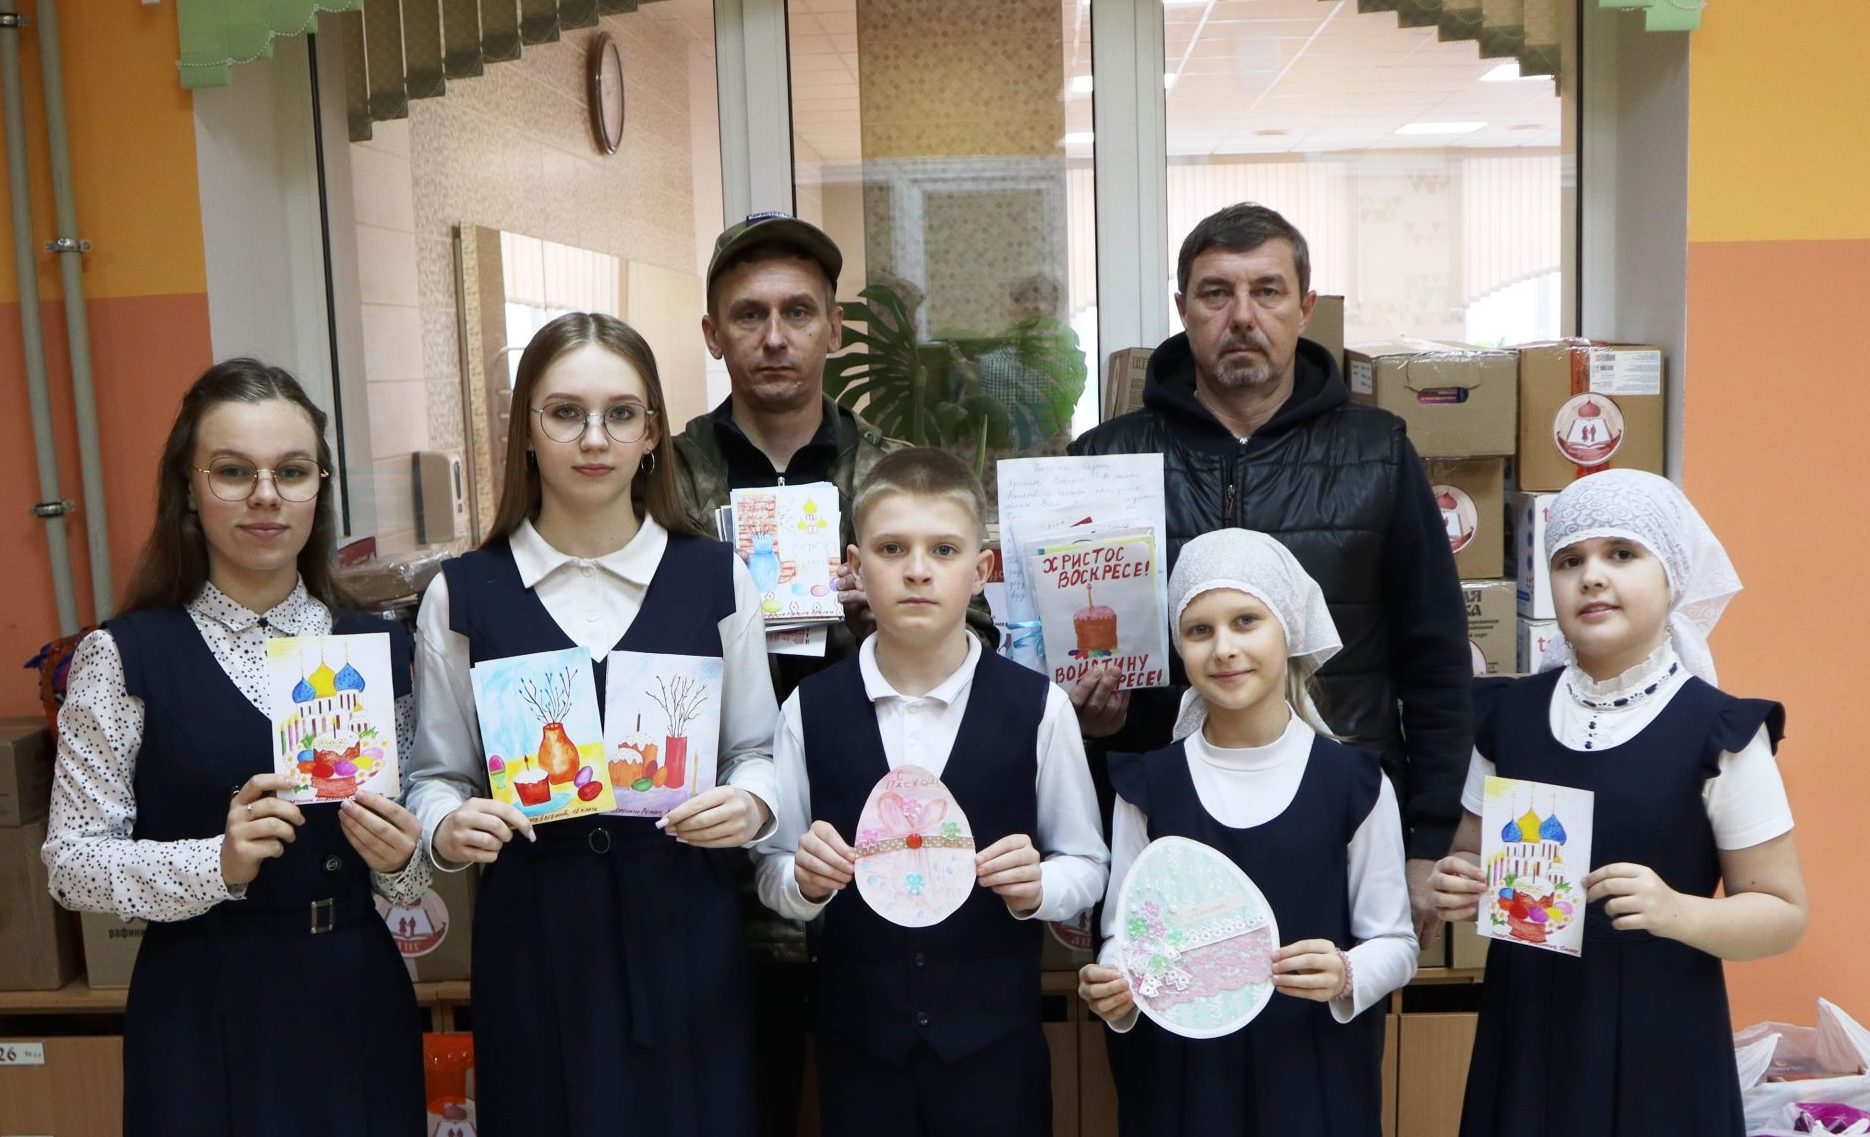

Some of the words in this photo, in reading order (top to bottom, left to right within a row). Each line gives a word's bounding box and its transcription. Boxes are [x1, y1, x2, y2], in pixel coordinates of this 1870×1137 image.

[1042, 547, 1125, 574] ХРИСТОС
[1057, 560, 1150, 589] ВОСКРЕСЕ!
[1076, 669, 1163, 690] РЕСЕ!
